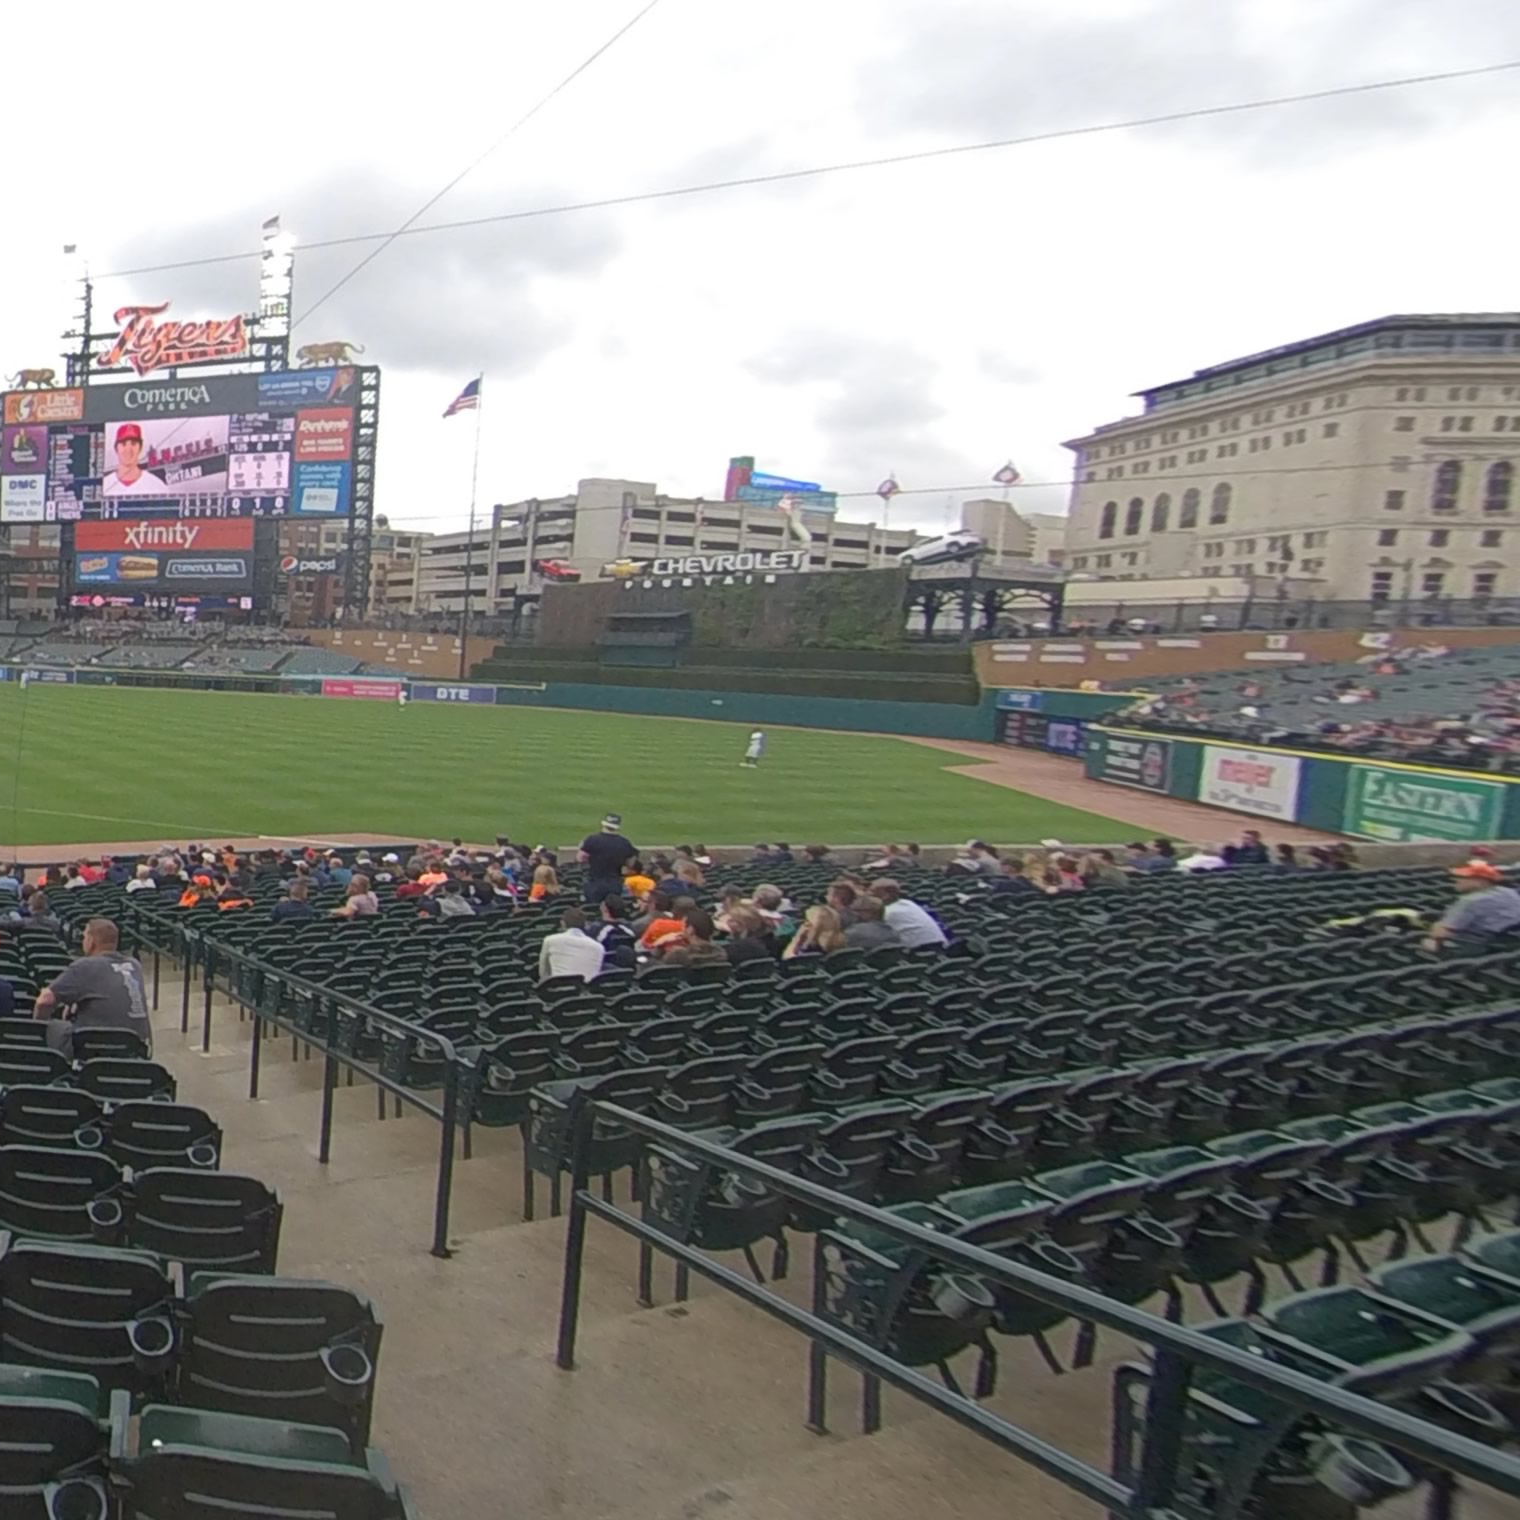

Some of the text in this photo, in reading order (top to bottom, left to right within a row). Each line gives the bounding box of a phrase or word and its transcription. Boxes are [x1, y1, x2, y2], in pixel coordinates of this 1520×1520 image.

[96, 299, 248, 377] Tigers
[9, 480, 37, 490] DMC
[124, 521, 199, 549] xfinity
[299, 558, 335, 572] pepsi
[652, 550, 806, 575] CHEVROLET
[436, 687, 470, 700] DTE
